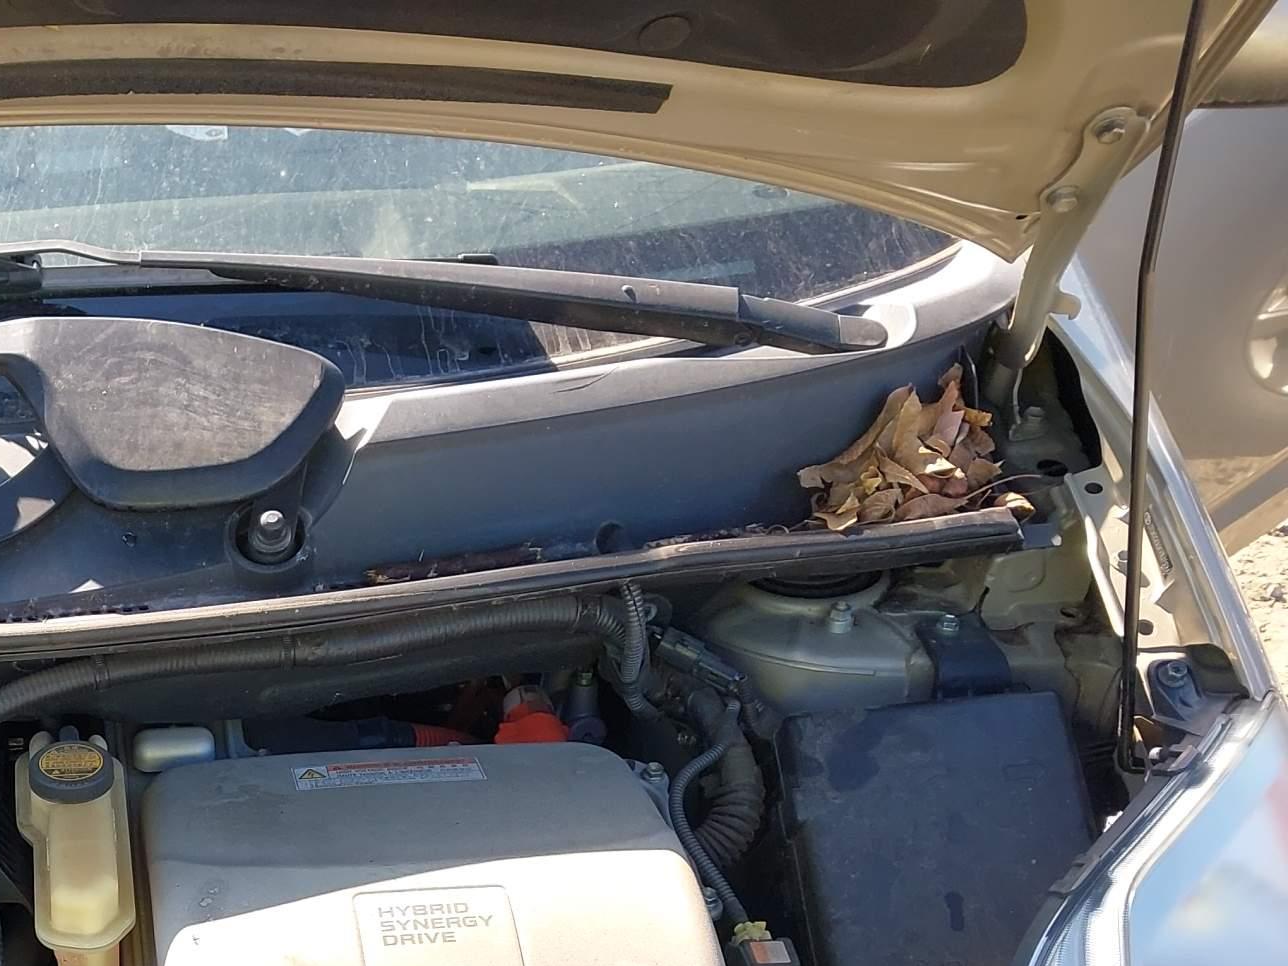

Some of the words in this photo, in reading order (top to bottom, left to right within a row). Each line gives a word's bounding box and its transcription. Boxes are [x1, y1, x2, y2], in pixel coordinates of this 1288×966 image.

[378, 902, 469, 918] HYBRID
[380, 914, 493, 932] SYNERGY
[382, 931, 457, 947] DRIVE
